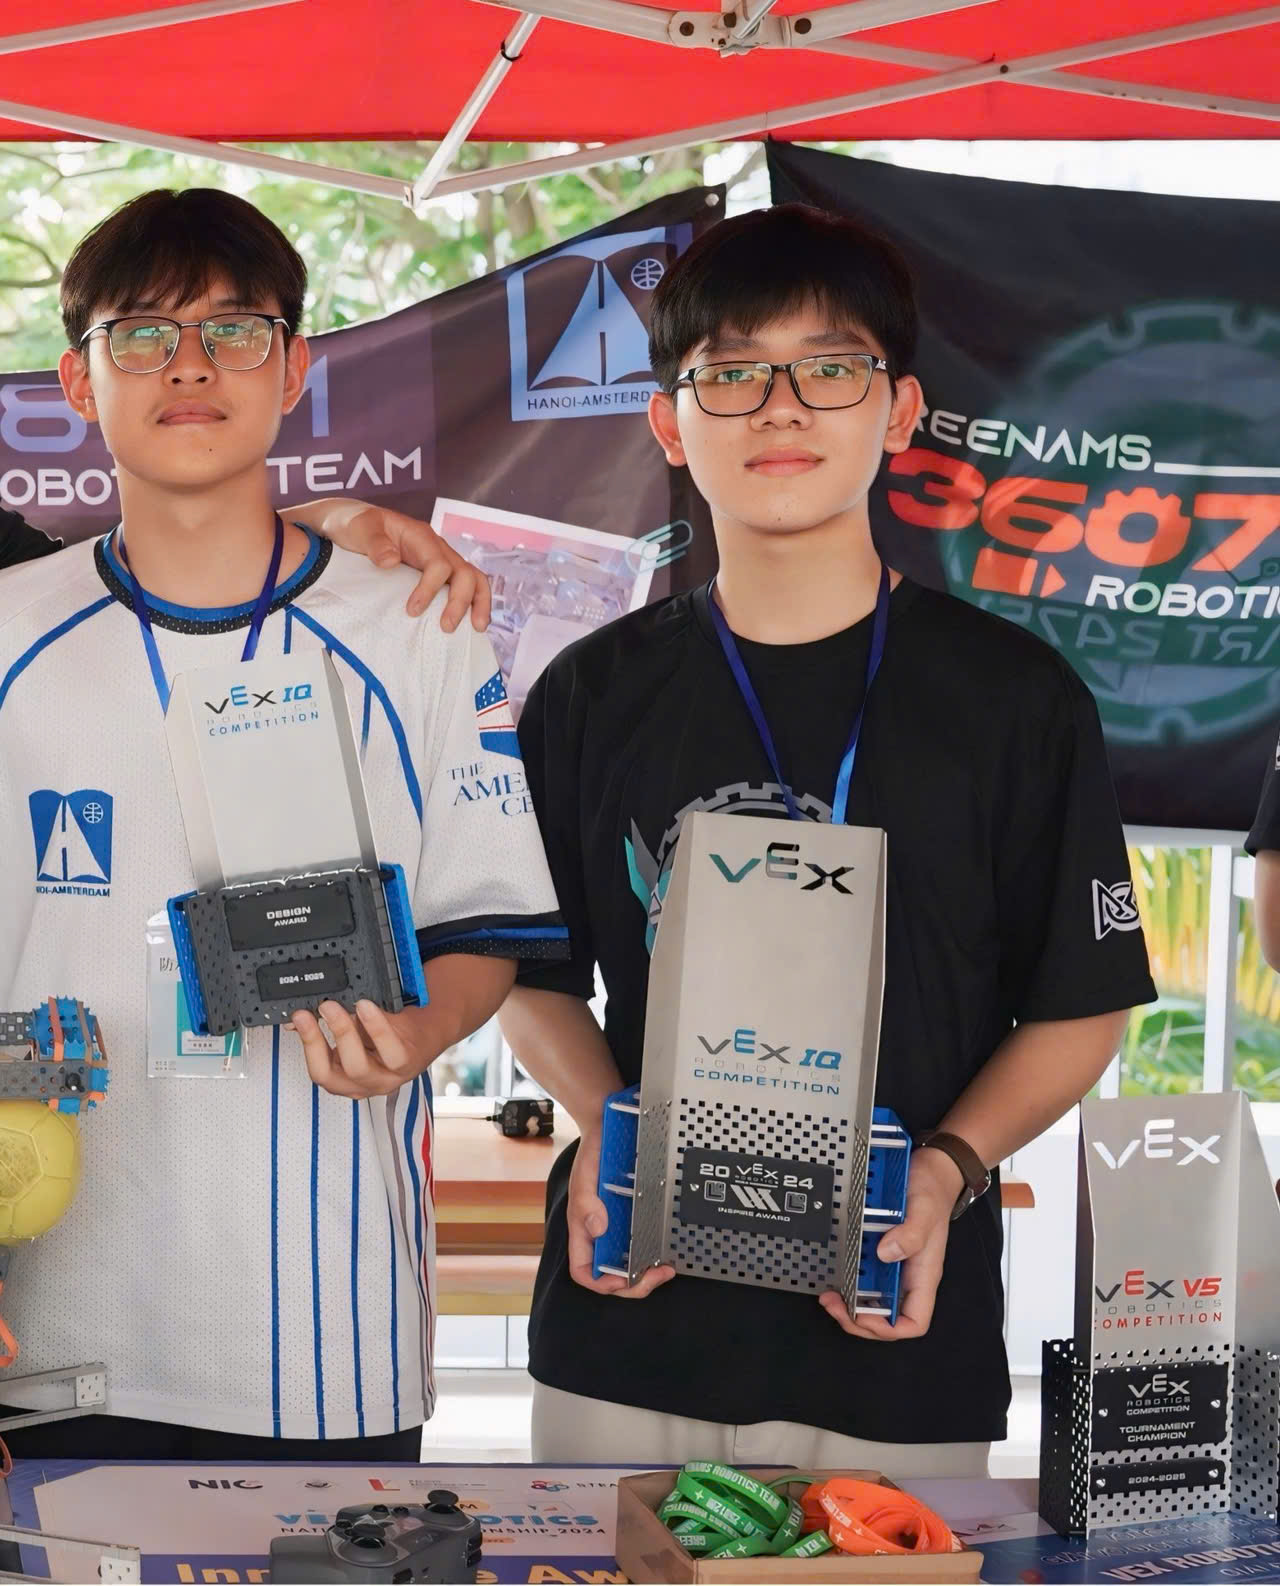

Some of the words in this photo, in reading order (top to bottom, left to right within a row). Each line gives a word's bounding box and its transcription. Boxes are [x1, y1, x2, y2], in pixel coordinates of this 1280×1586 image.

[266, 446, 422, 495] TEAM
[887, 448, 1280, 572] 3607
[1085, 574, 1280, 620] ROBOTI
[204, 685, 277, 714] VEX
[283, 684, 312, 703] IQ
[209, 711, 319, 737] COMPETITION
[453, 774, 530, 806] AME
[708, 842, 855, 895] VEX
[266, 906, 312, 920] DESIGN
[274, 916, 308, 927] AWARD
[697, 1029, 791, 1064] VEX
[799, 1048, 842, 1070] IQ
[694, 1069, 840, 1096] COMPETITION
[1092, 1119, 1222, 1169] VEX
[699, 1163, 730, 1178] 20
[736, 1163, 779, 1180] VEX
[783, 1175, 814, 1190] 24
[718, 1207, 755, 1217] INSPIRE
[755, 1212, 791, 1222] AWARD
[1095, 1269, 1175, 1303] VEX
[1183, 1277, 1223, 1297] V5
[1094, 1312, 1222, 1331] OMPETITION
[1128, 1373, 1190, 1398] VEX
[1126, 1405, 1190, 1416] COMPETITION
[1120, 1421, 1196, 1434] TOURNAMENT
[1128, 1432, 1187, 1443] CHAMPION
[713, 1465, 759, 1493] ROBOTICS
[759, 1486, 781, 1510] TEAM
[1098, 1560, 1174, 1582] VEX
